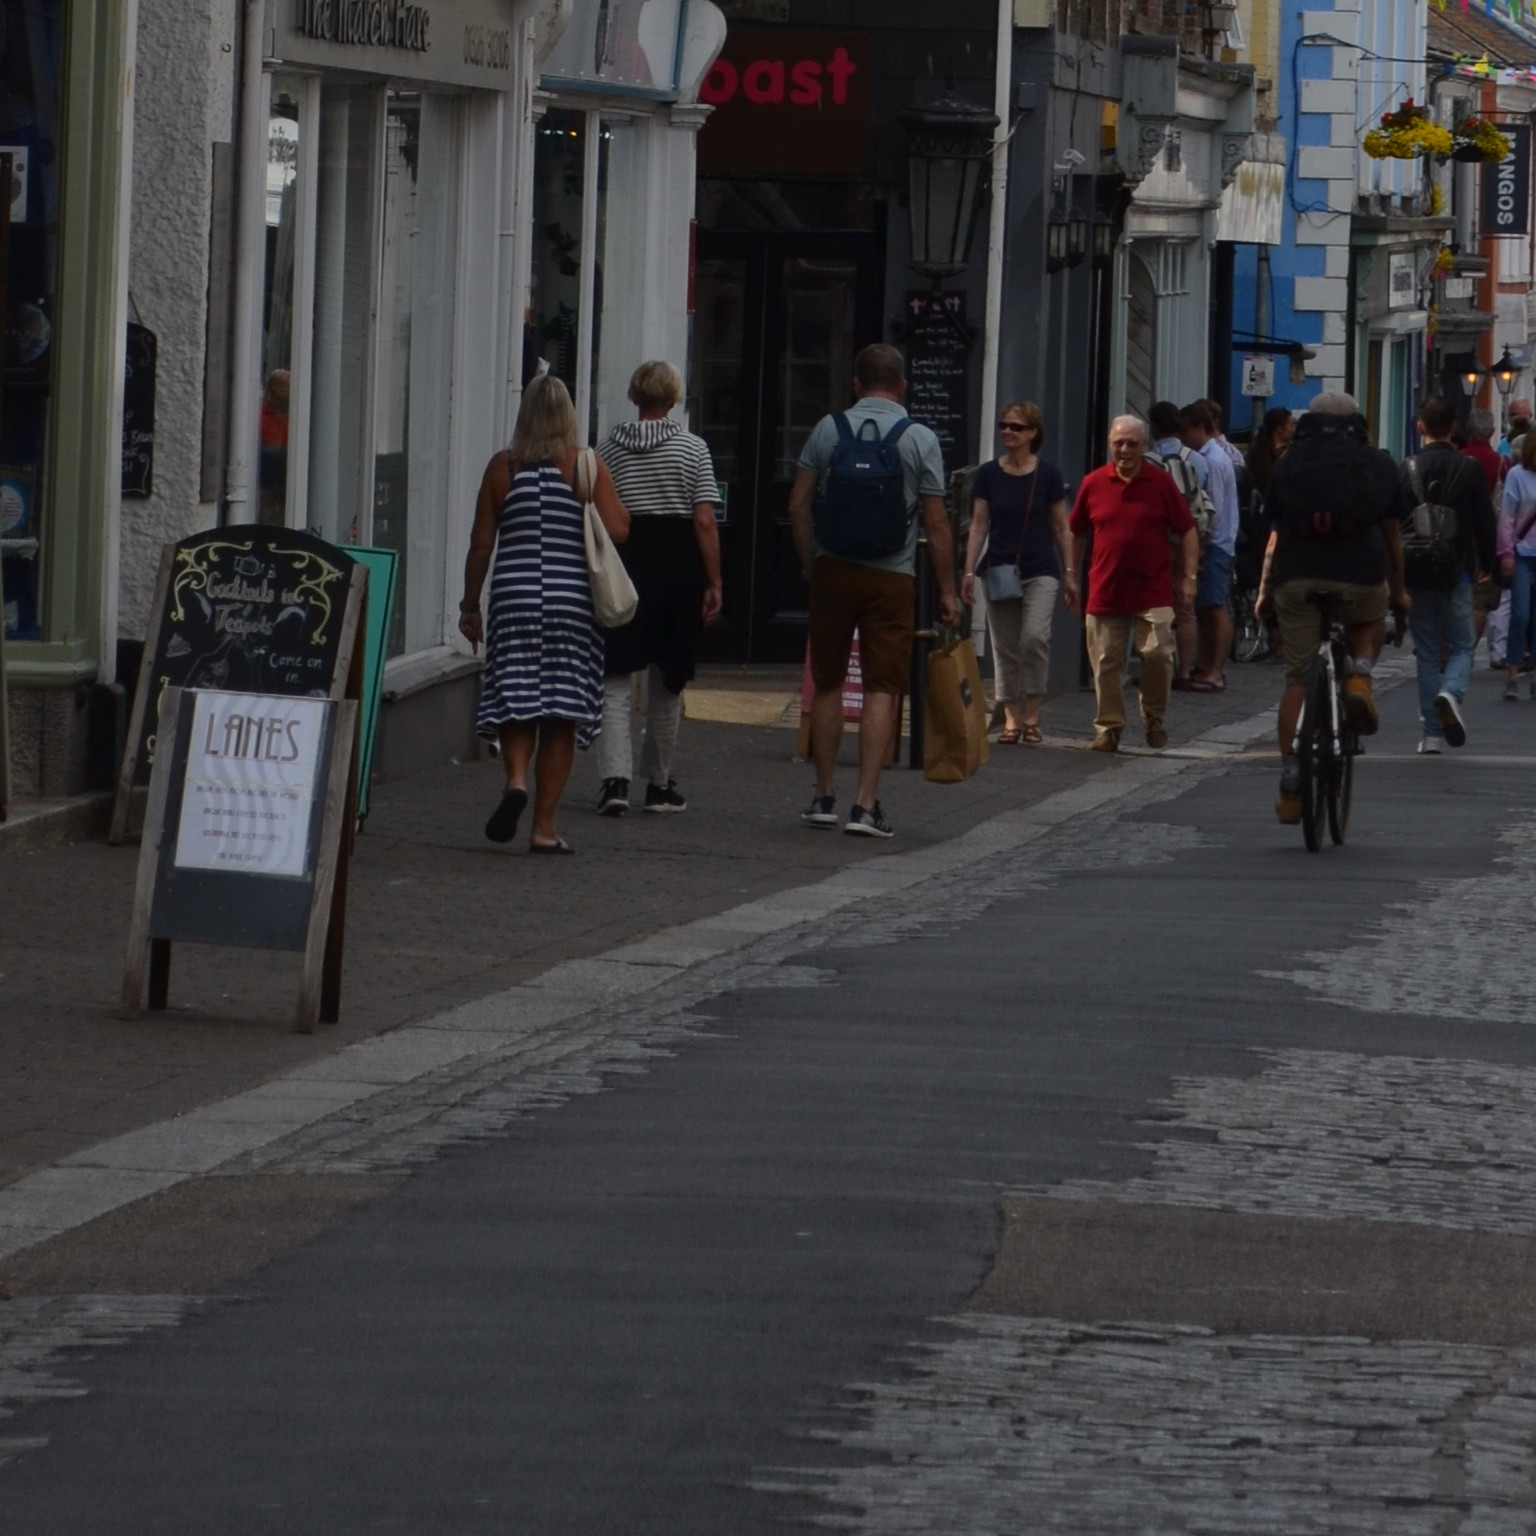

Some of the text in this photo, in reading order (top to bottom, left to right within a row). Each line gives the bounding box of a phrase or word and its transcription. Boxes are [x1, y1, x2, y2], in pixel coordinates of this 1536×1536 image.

[206, 571, 276, 604] Cocktails
[269, 651, 323, 670] Come on
[204, 712, 301, 764] LANES
